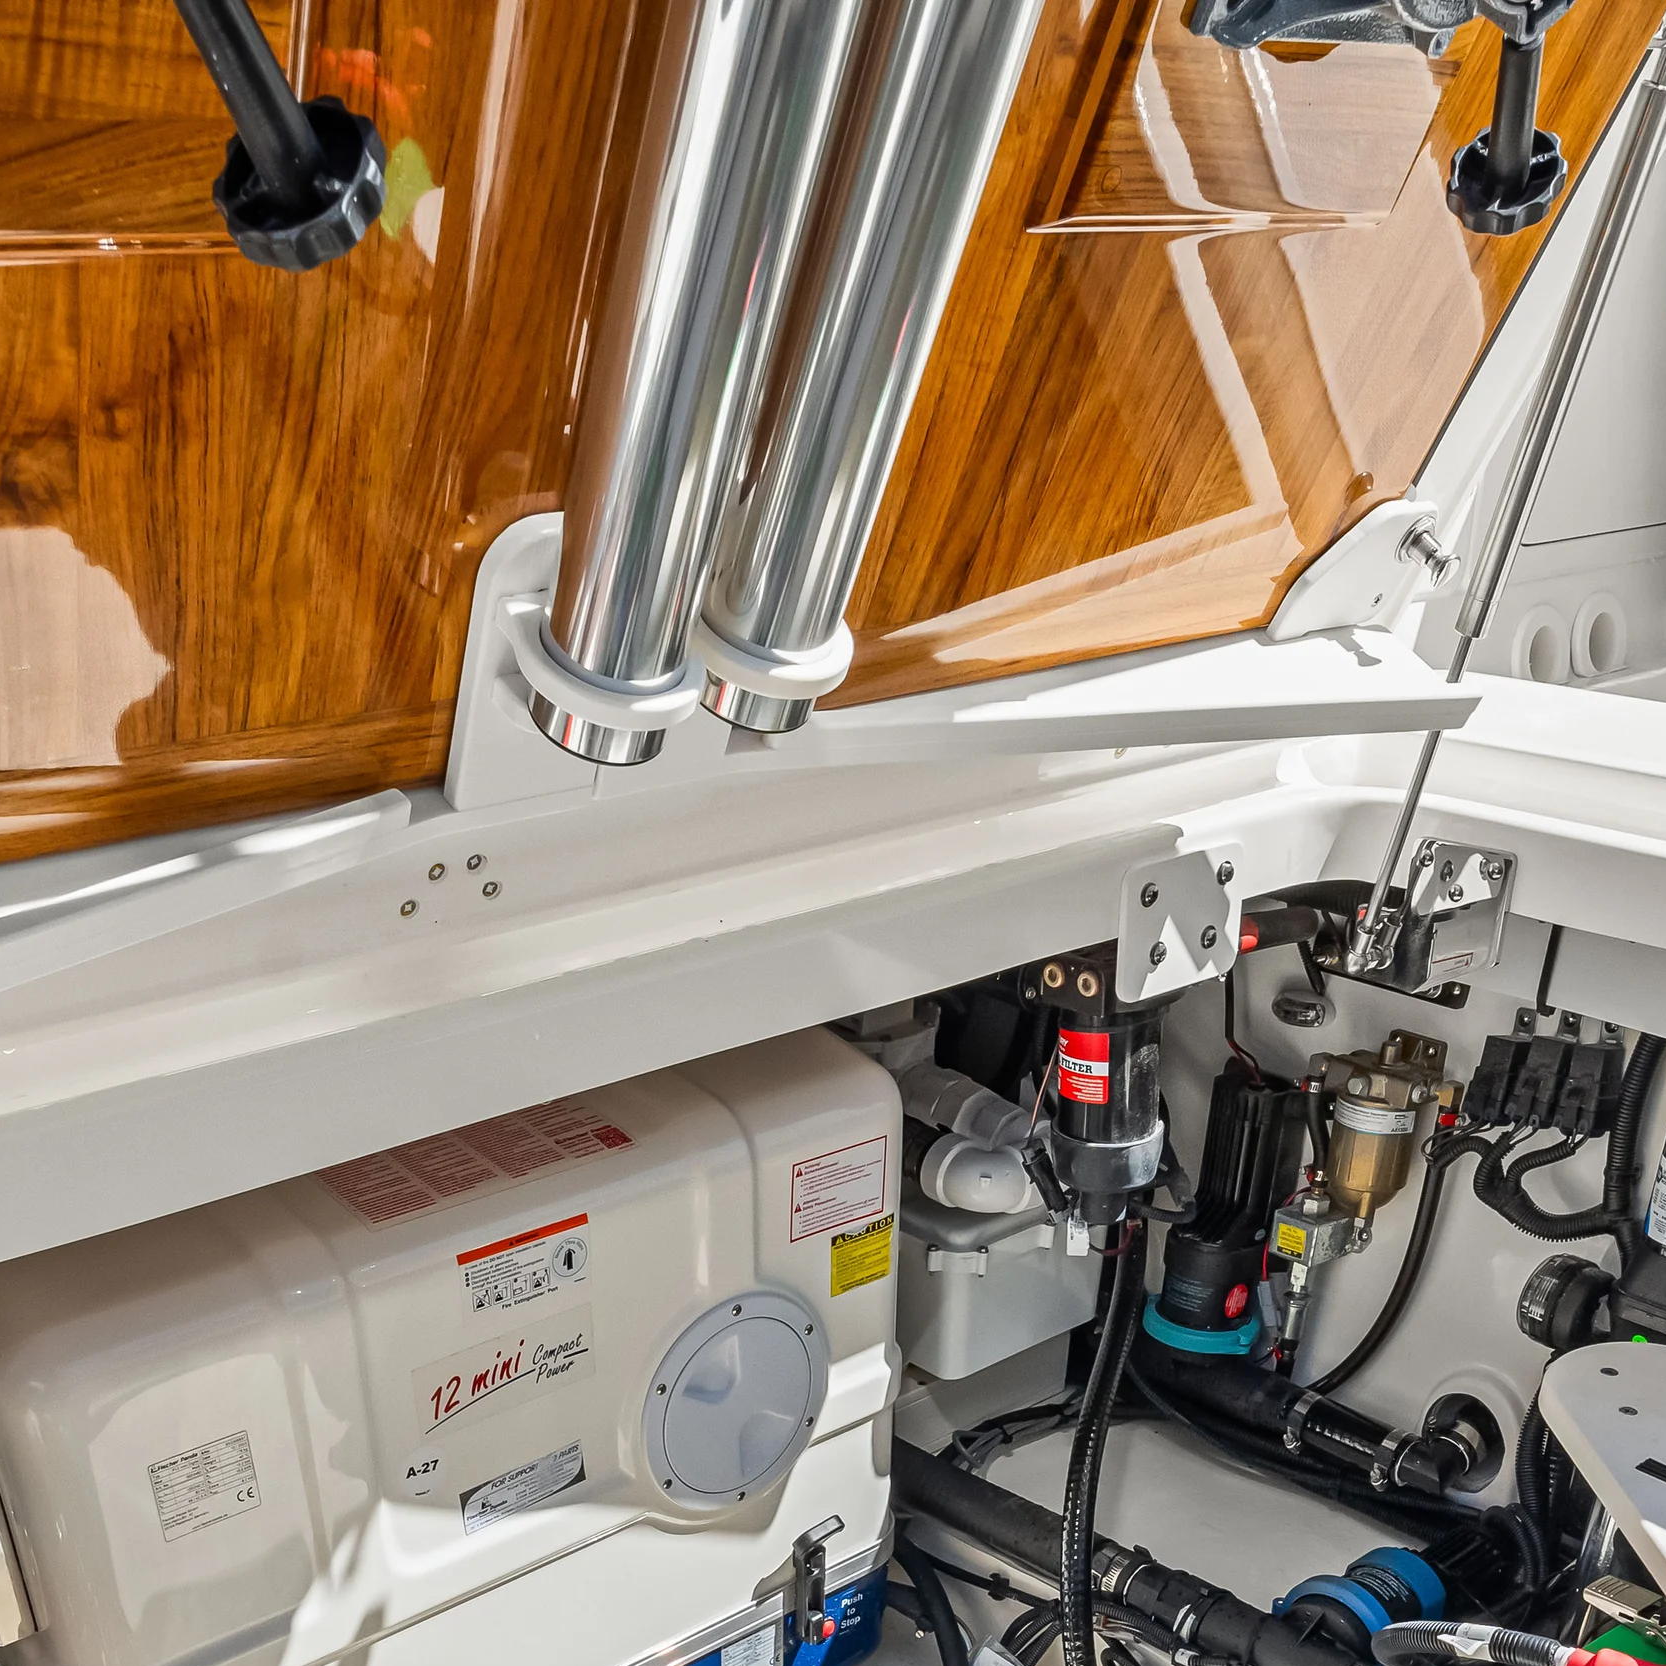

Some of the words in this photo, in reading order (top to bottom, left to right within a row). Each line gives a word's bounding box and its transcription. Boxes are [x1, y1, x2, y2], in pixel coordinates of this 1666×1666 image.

[1061, 1056, 1092, 1074] FILTER
[502, 1302, 511, 1310] Fire
[548, 1286, 558, 1294] Port
[533, 1333, 583, 1365] Compact
[431, 1376, 461, 1420] 12
[471, 1339, 524, 1396] mini
[536, 1360, 575, 1383] Power
[406, 1459, 439, 1479] A-27
[237, 1487, 255, 1501] CE
[841, 1593, 863, 1608] Push
[847, 1608, 855, 1616] to
[841, 1616, 861, 1629] Stop
